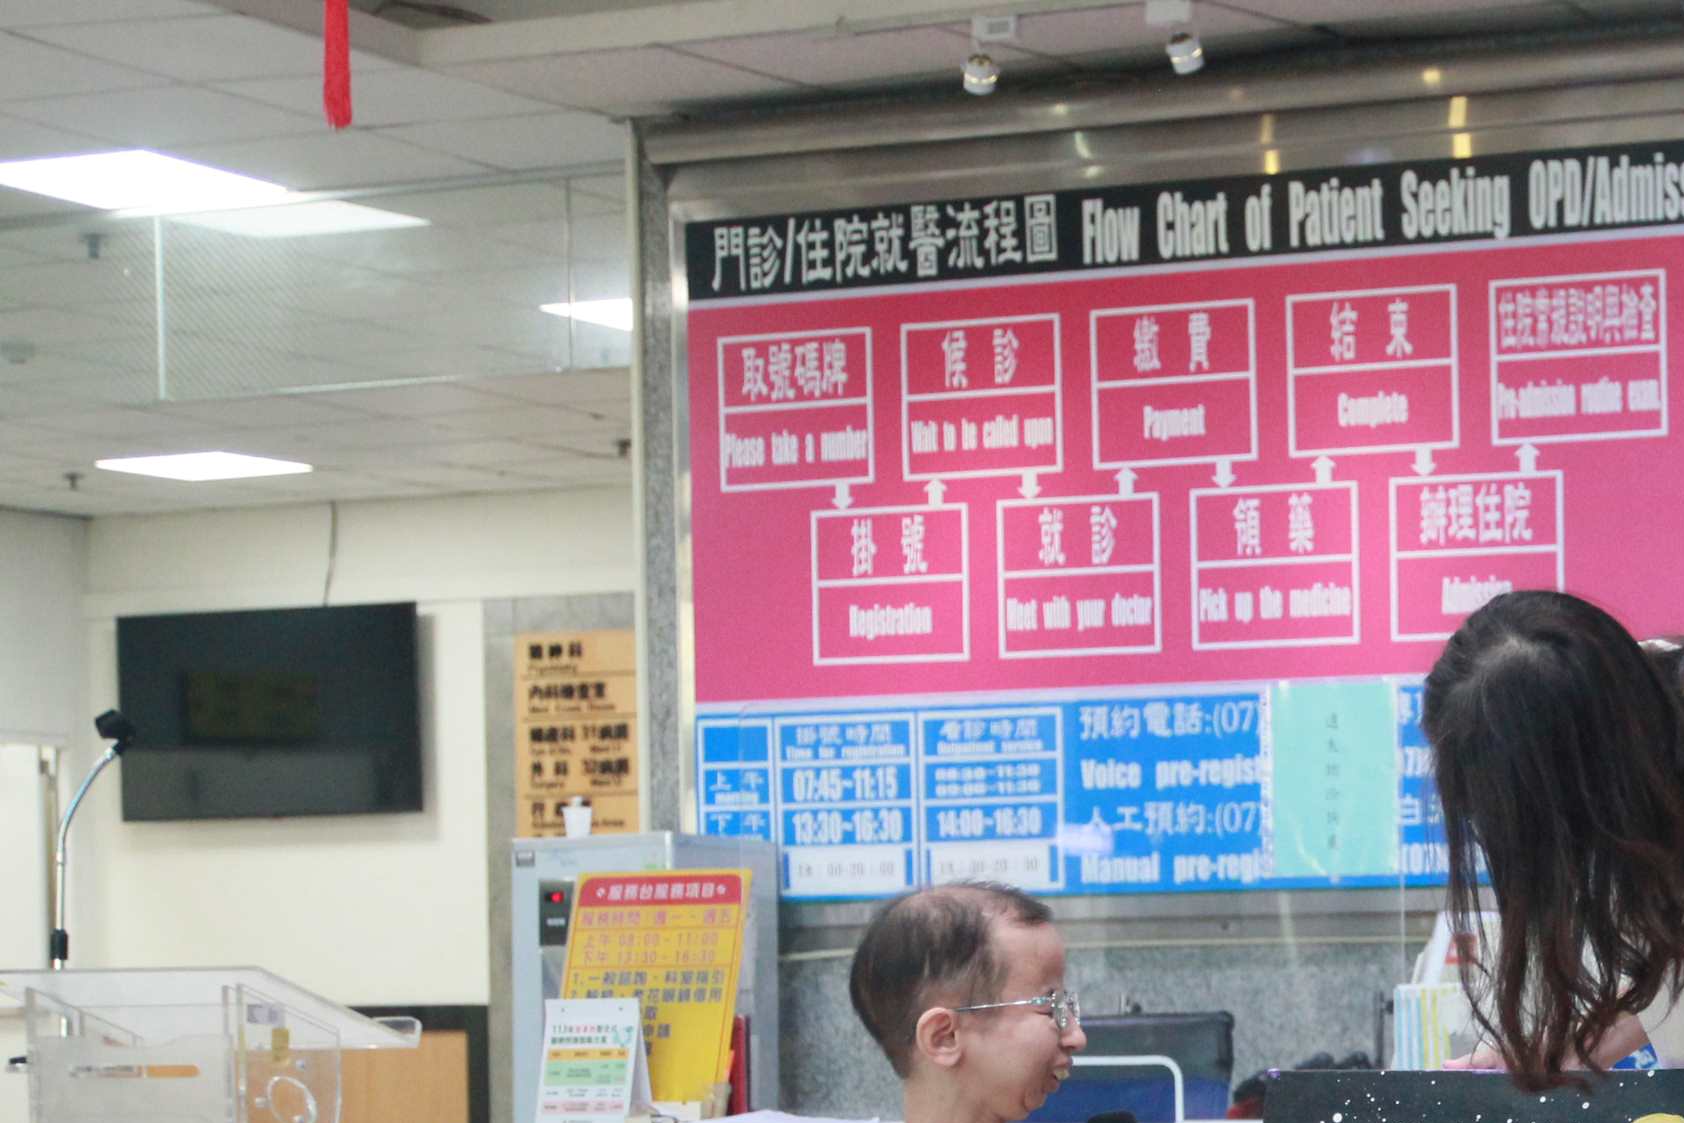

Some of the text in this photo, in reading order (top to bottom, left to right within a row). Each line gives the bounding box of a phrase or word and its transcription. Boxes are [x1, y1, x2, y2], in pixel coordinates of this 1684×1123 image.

[712, 194, 1057, 290] 門診/住院就醫流程圖
[1082, 199, 1140, 264] Flow
[1158, 191, 1229, 259] Chart
[1245, 184, 1272, 252] of
[1289, 177, 1384, 248] Patient
[1402, 166, 1511, 240] Seeking
[941, 327, 1020, 388] 候診
[1329, 298, 1413, 361] 結束
[740, 338, 849, 402] 取號碼牌
[1143, 404, 1207, 441] Payment
[1337, 390, 1410, 428] Complete
[725, 431, 765, 469] Please
[771, 430, 798, 464] take
[820, 425, 869, 463] number
[1038, 504, 1118, 566] 就診
[1233, 493, 1315, 557] 領藥
[1419, 482, 1534, 545] 辦理住院
[850, 514, 929, 576] 掛號
[849, 602, 933, 640] Registration
[1080, 758, 1142, 789] Voice
[1081, 850, 1160, 884] Manual
